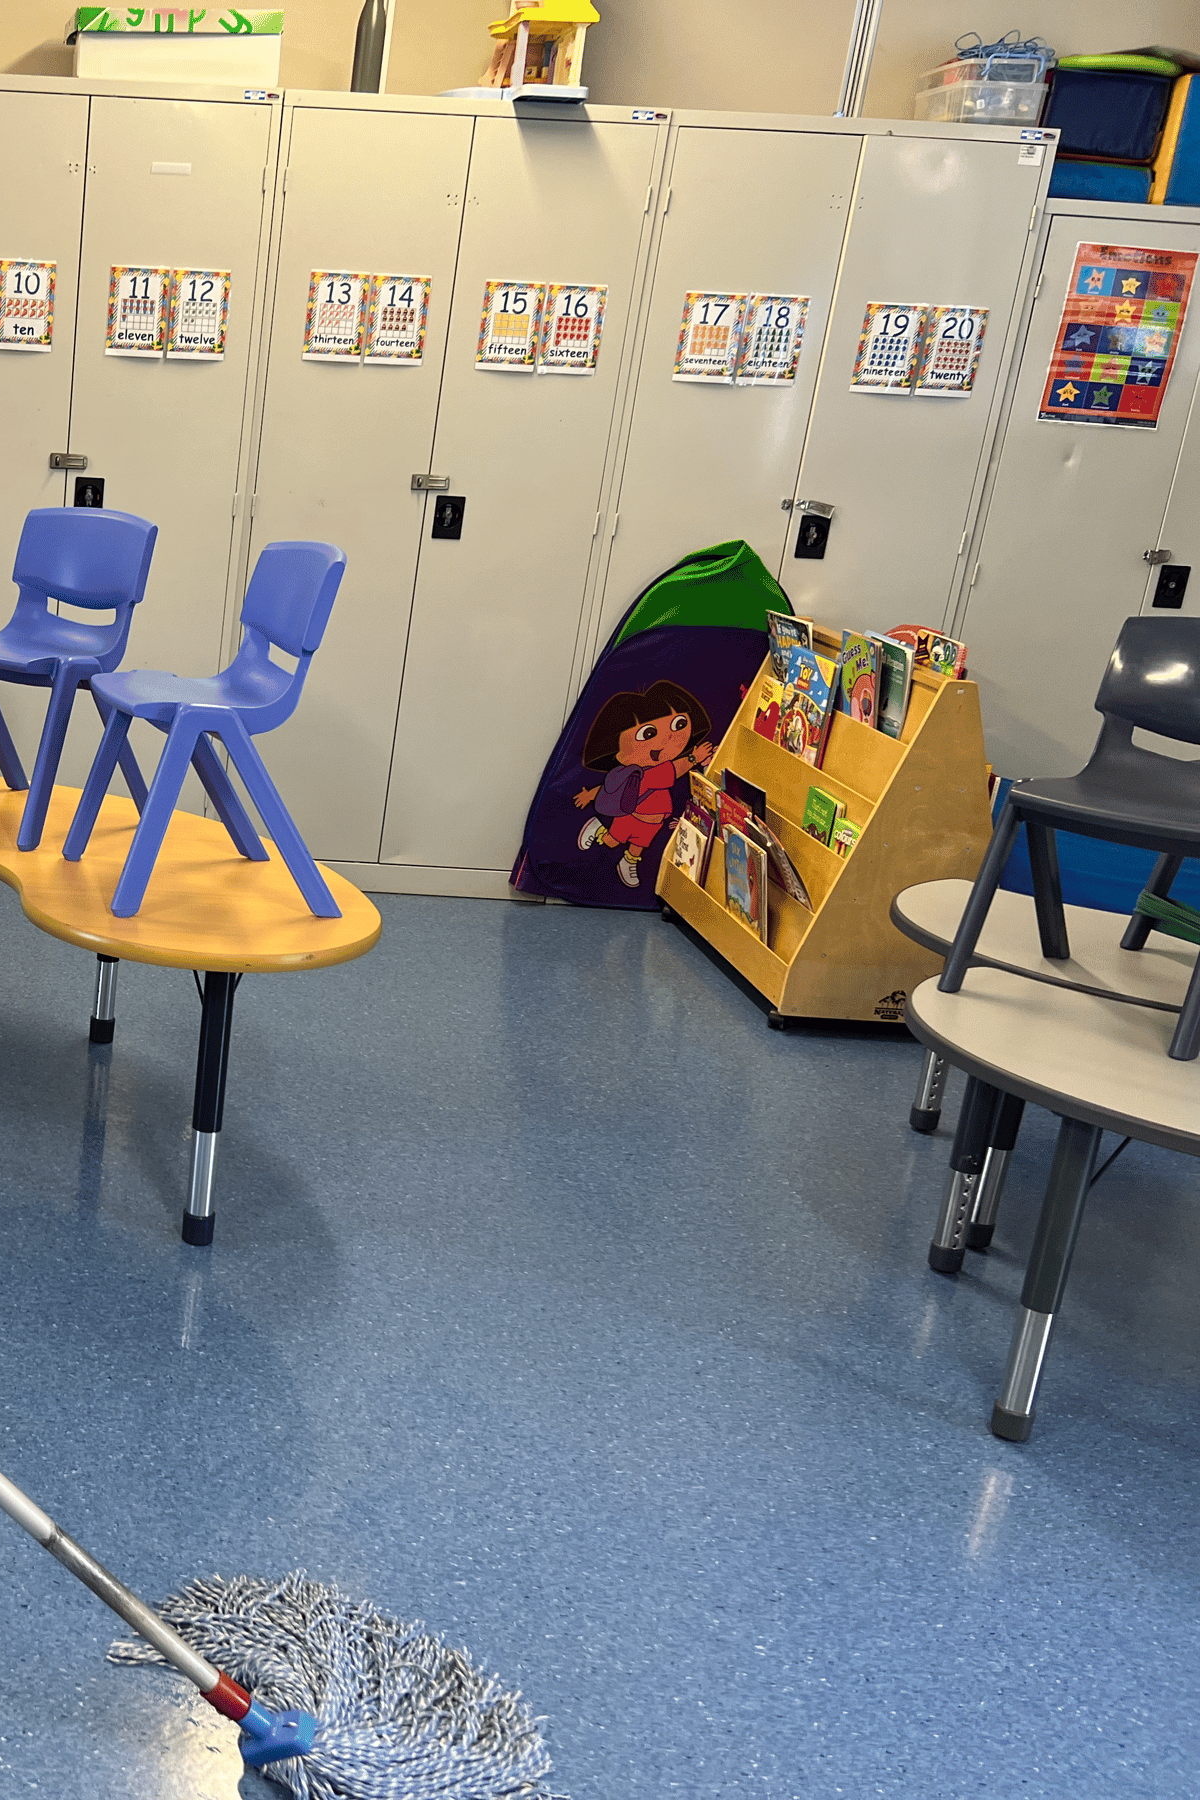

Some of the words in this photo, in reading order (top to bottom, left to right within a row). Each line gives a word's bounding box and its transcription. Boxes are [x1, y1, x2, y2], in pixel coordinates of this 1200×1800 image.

[13, 271, 41, 296] 10
[128, 276, 151, 300] 11
[187, 279, 215, 303] 12
[325, 281, 352, 306] 13
[387, 284, 415, 308] 14
[499, 291, 528, 315] 15
[561, 294, 589, 318] 16
[698, 302, 731, 327] 17
[762, 304, 790, 329] 18
[879, 313, 910, 338] 19
[13, 323, 35, 337] ten
[117, 328, 155, 342] eleven
[941, 316, 974, 340] 20
[178, 332, 216, 346] twelve
[313, 333, 355, 347] thirteen
[376, 335, 416, 349] fourteen
[488, 343, 527, 357] fifteen
[549, 346, 589, 360] sixteen
[684, 355, 728, 368] seventeen
[747, 357, 790, 372] eighteen
[863, 366, 906, 379] nineteen
[930, 369, 968, 384] twenty
